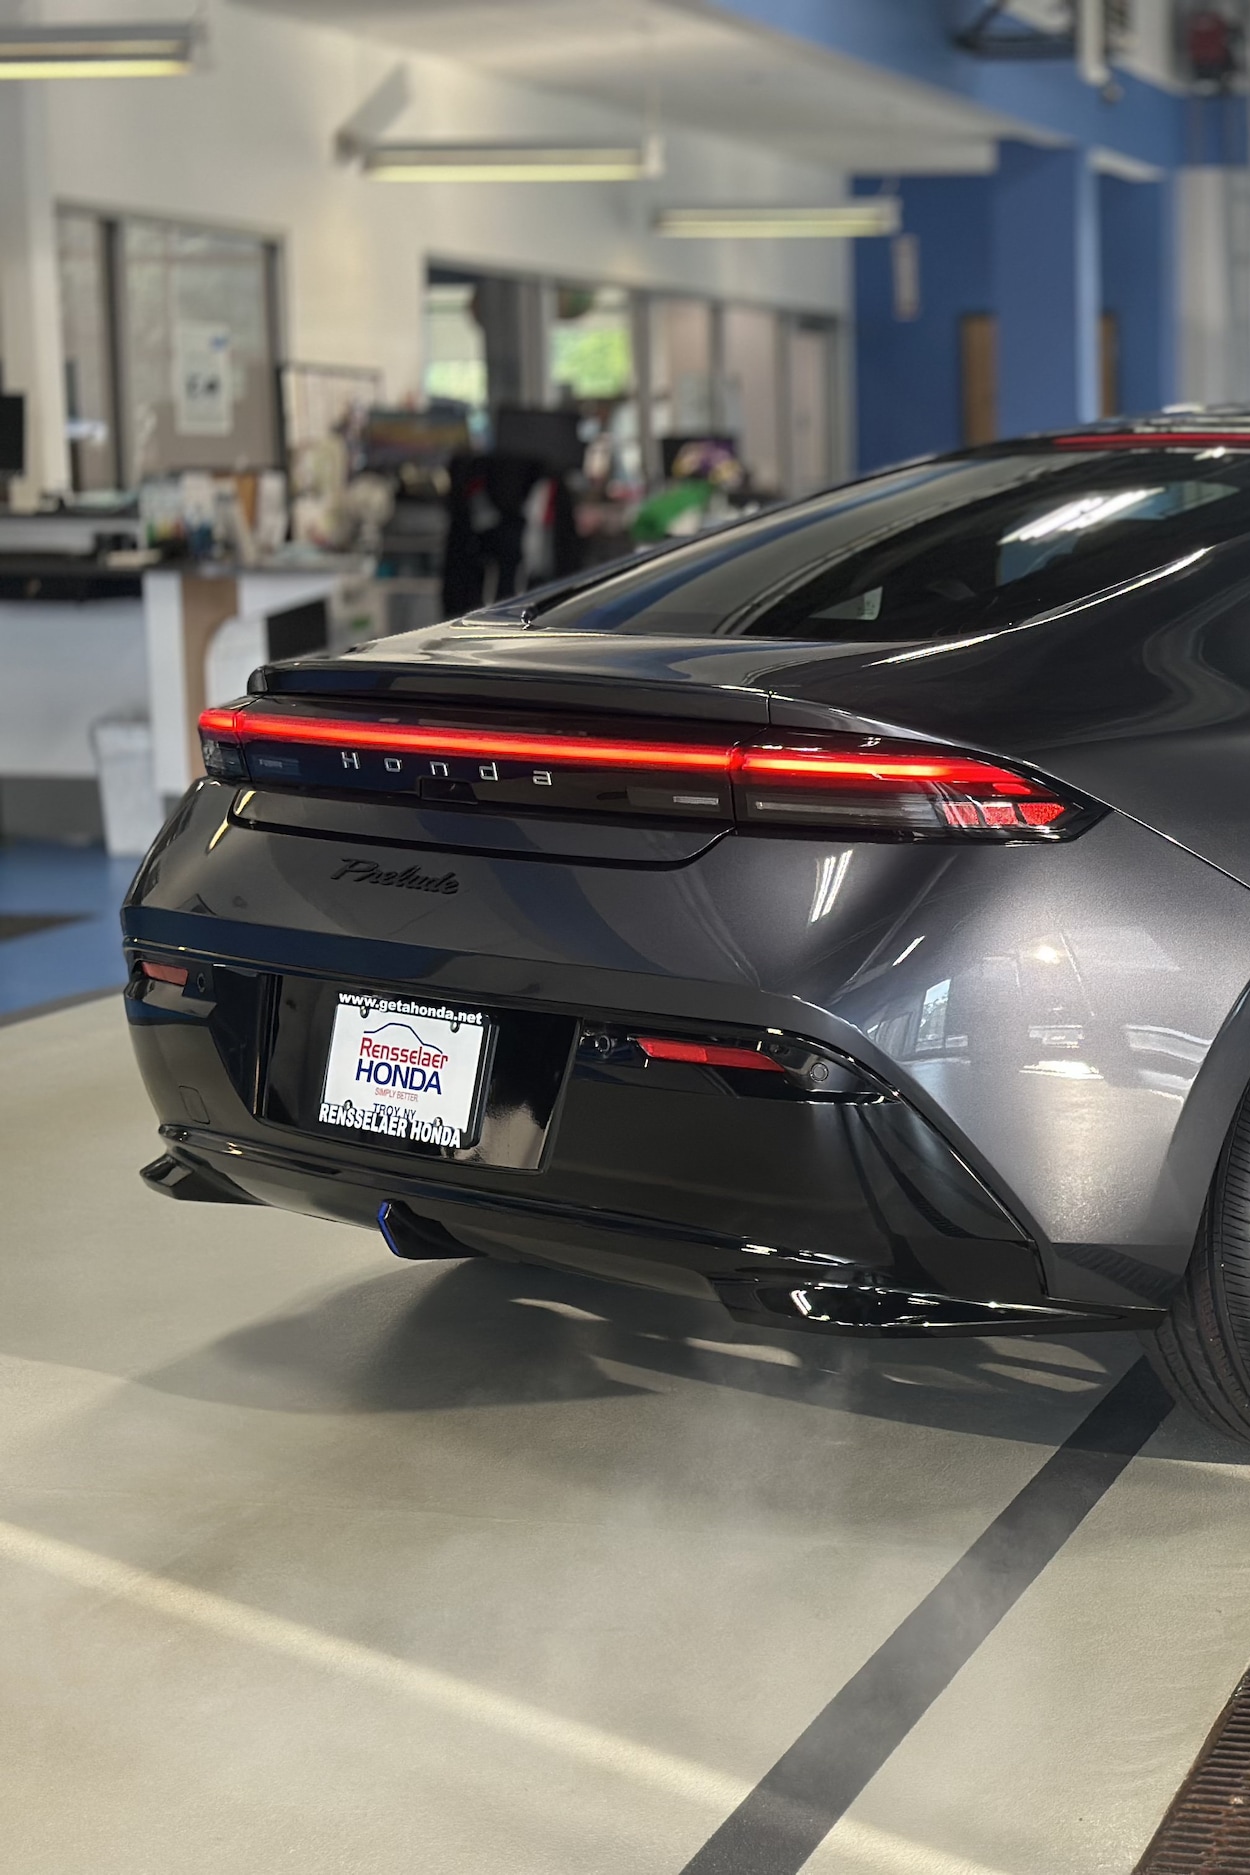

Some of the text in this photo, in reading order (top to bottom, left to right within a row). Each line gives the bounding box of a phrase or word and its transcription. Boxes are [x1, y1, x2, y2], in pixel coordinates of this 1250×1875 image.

[331, 858, 460, 895] Prelude
[338, 992, 483, 1025] www.getahonda.net
[360, 1037, 448, 1070] Rensselaer
[356, 1059, 442, 1095] HONDA
[375, 1087, 419, 1102] SIMPLY BETTER
[318, 1102, 461, 1149] RENSSELAER HONDA
[403, 1108, 417, 1120] NY
